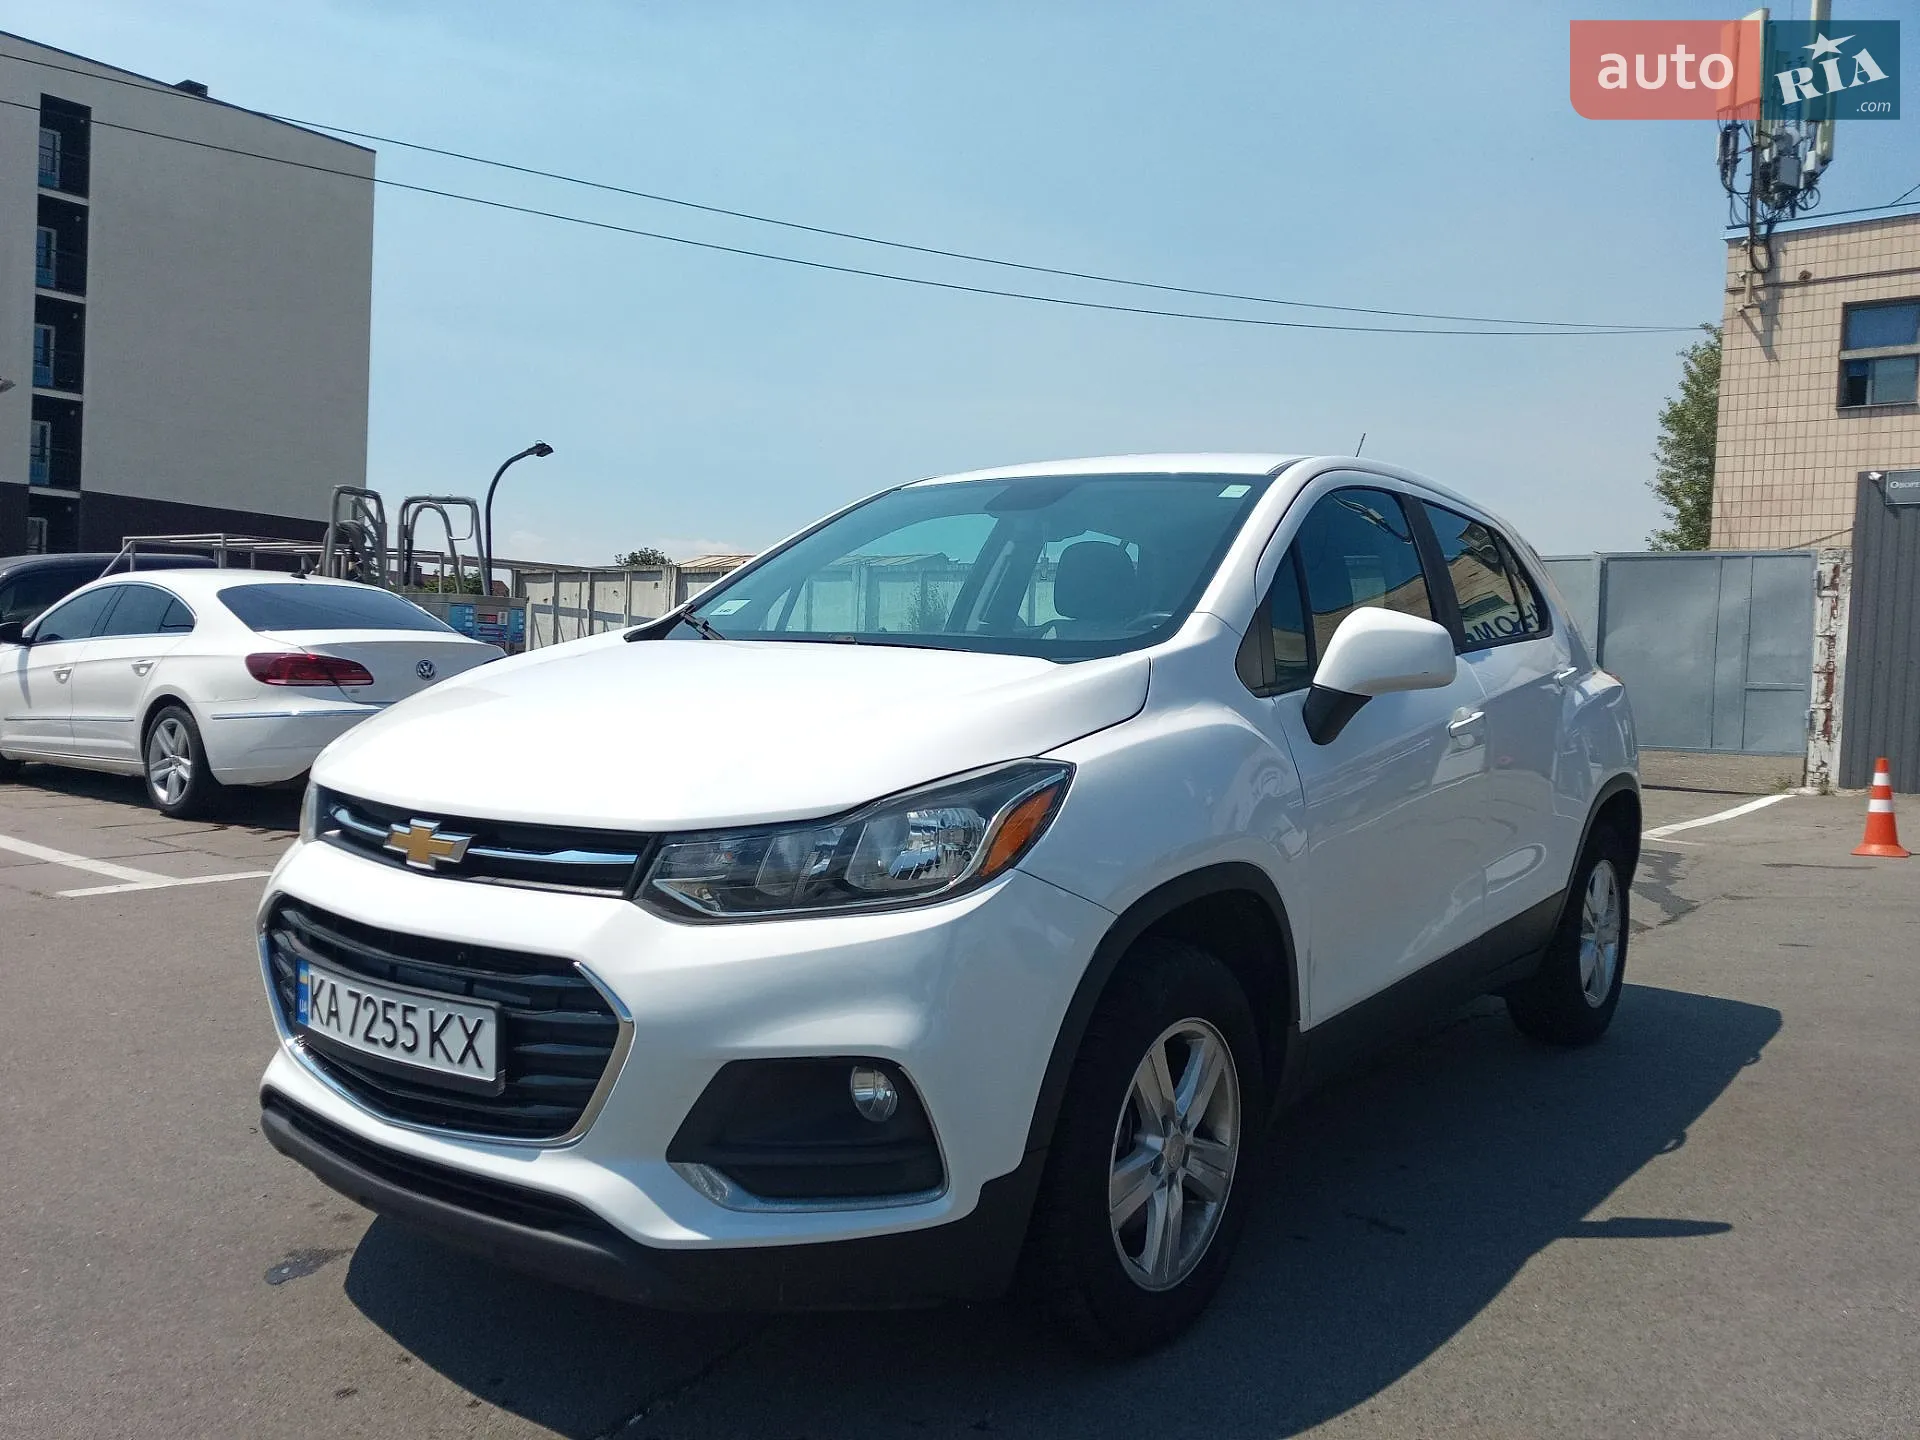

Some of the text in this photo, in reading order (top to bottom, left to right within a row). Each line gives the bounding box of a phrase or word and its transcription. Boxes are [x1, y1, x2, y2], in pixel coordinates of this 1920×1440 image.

[309, 974, 484, 1069] KA 7255 KX
